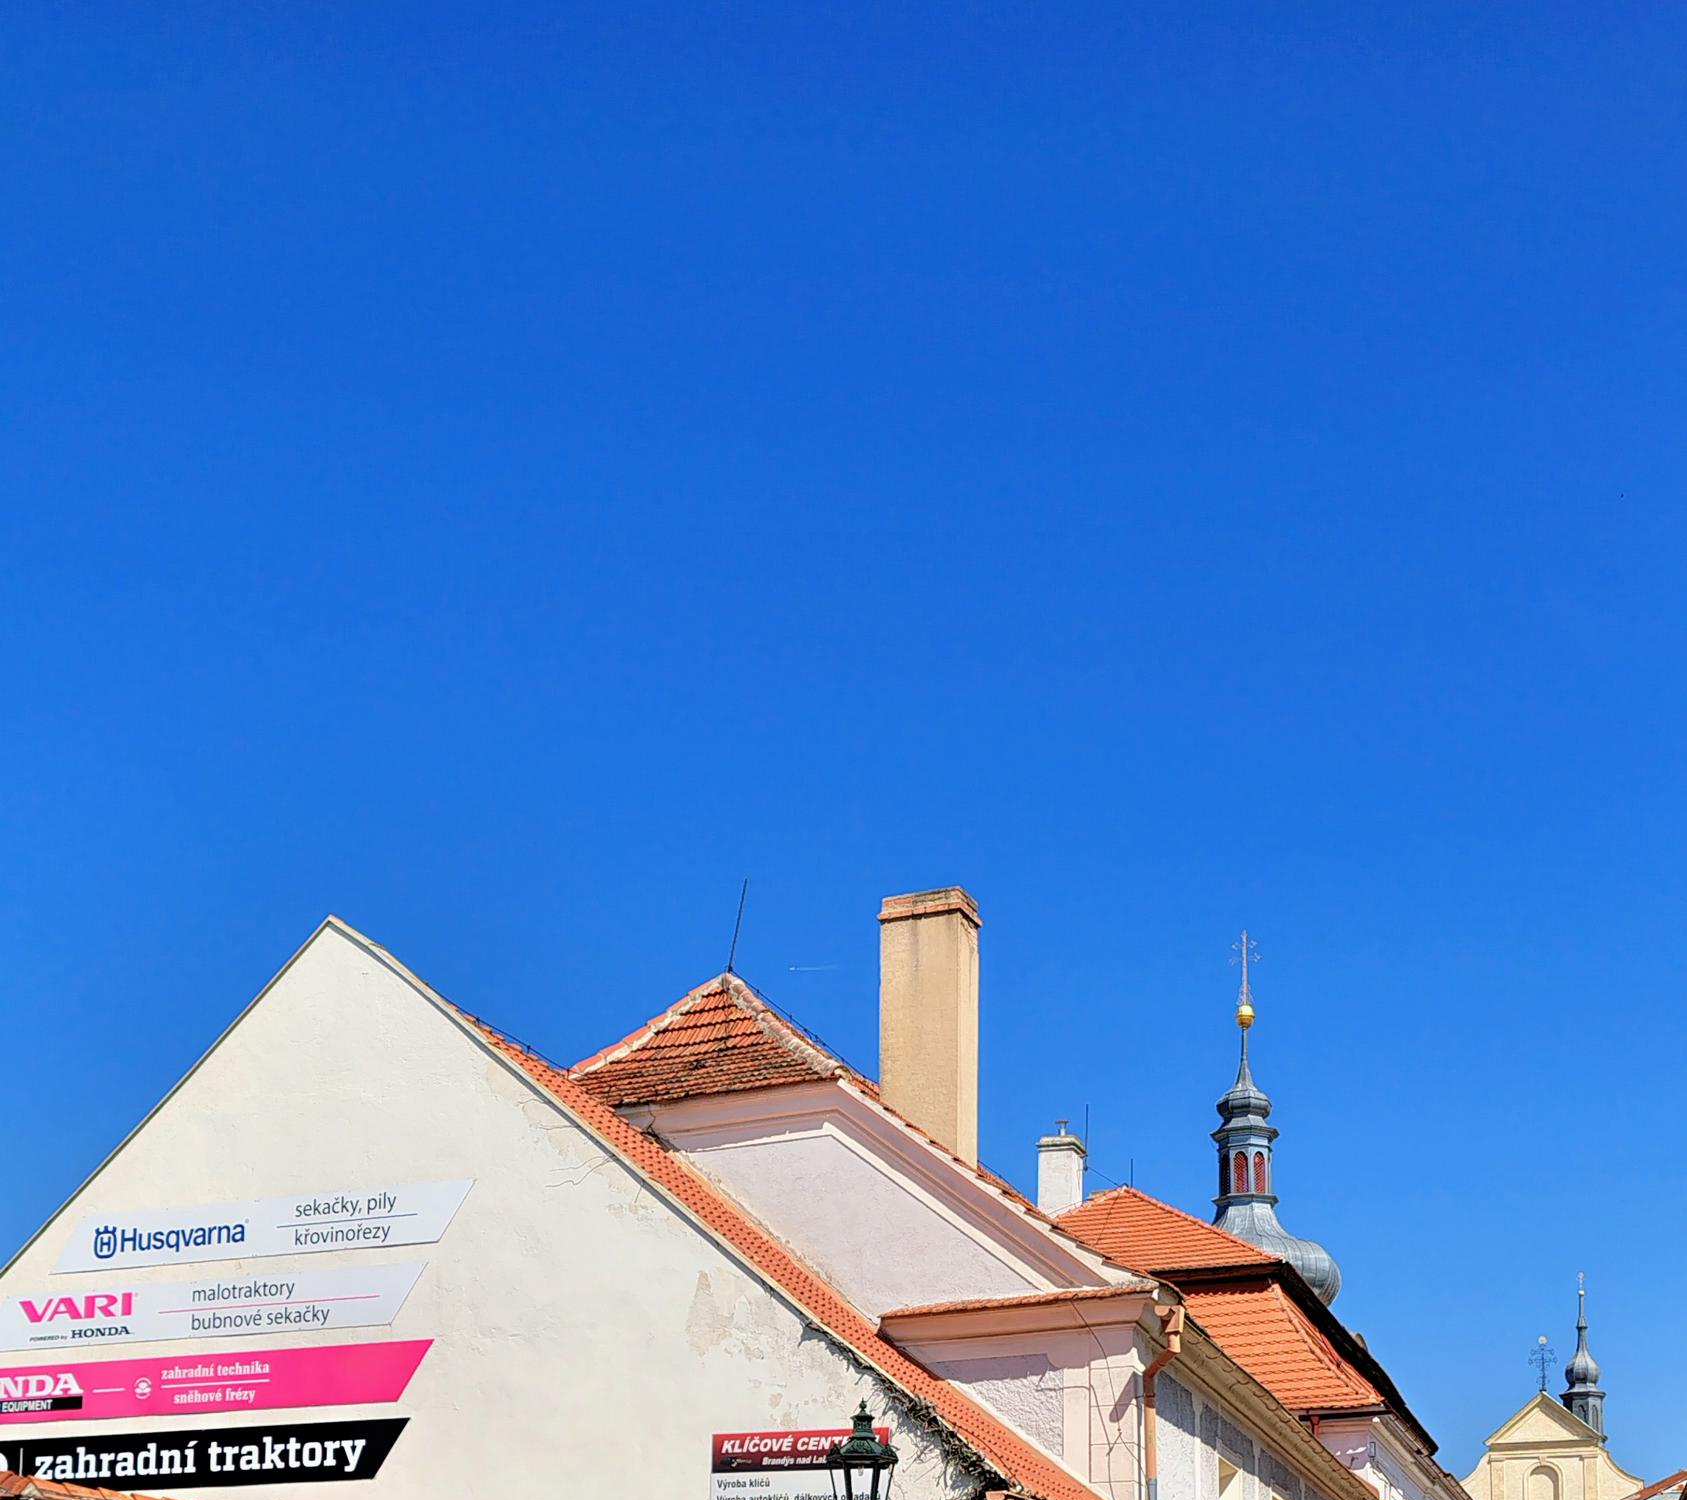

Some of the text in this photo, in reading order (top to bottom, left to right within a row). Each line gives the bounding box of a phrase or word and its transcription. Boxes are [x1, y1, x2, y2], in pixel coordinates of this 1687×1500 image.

[295, 1191, 397, 1218] sekačky, pily
[120, 1223, 245, 1253] Husqvarna
[294, 1222, 391, 1246] křovinořezy
[192, 1280, 295, 1302] malotraktory
[18, 1292, 133, 1323] VARI
[191, 1306, 330, 1331] bubnové sekačky
[70, 1326, 131, 1339] HONDA
[161, 1359, 270, 1380] zahradní technika
[2, 1399, 53, 1412] EQUIPMENT
[174, 1387, 256, 1405] sněhové frézy
[721, 1433, 794, 1453] KLÍČOVÉ
[34, 1440, 198, 1480] zahradní
[208, 1438, 367, 1473] traktory
[761, 1456, 795, 1467] Brandýs
[796, 1456, 812, 1465] nad
[717, 1476, 770, 1490] Výroba klíčů
